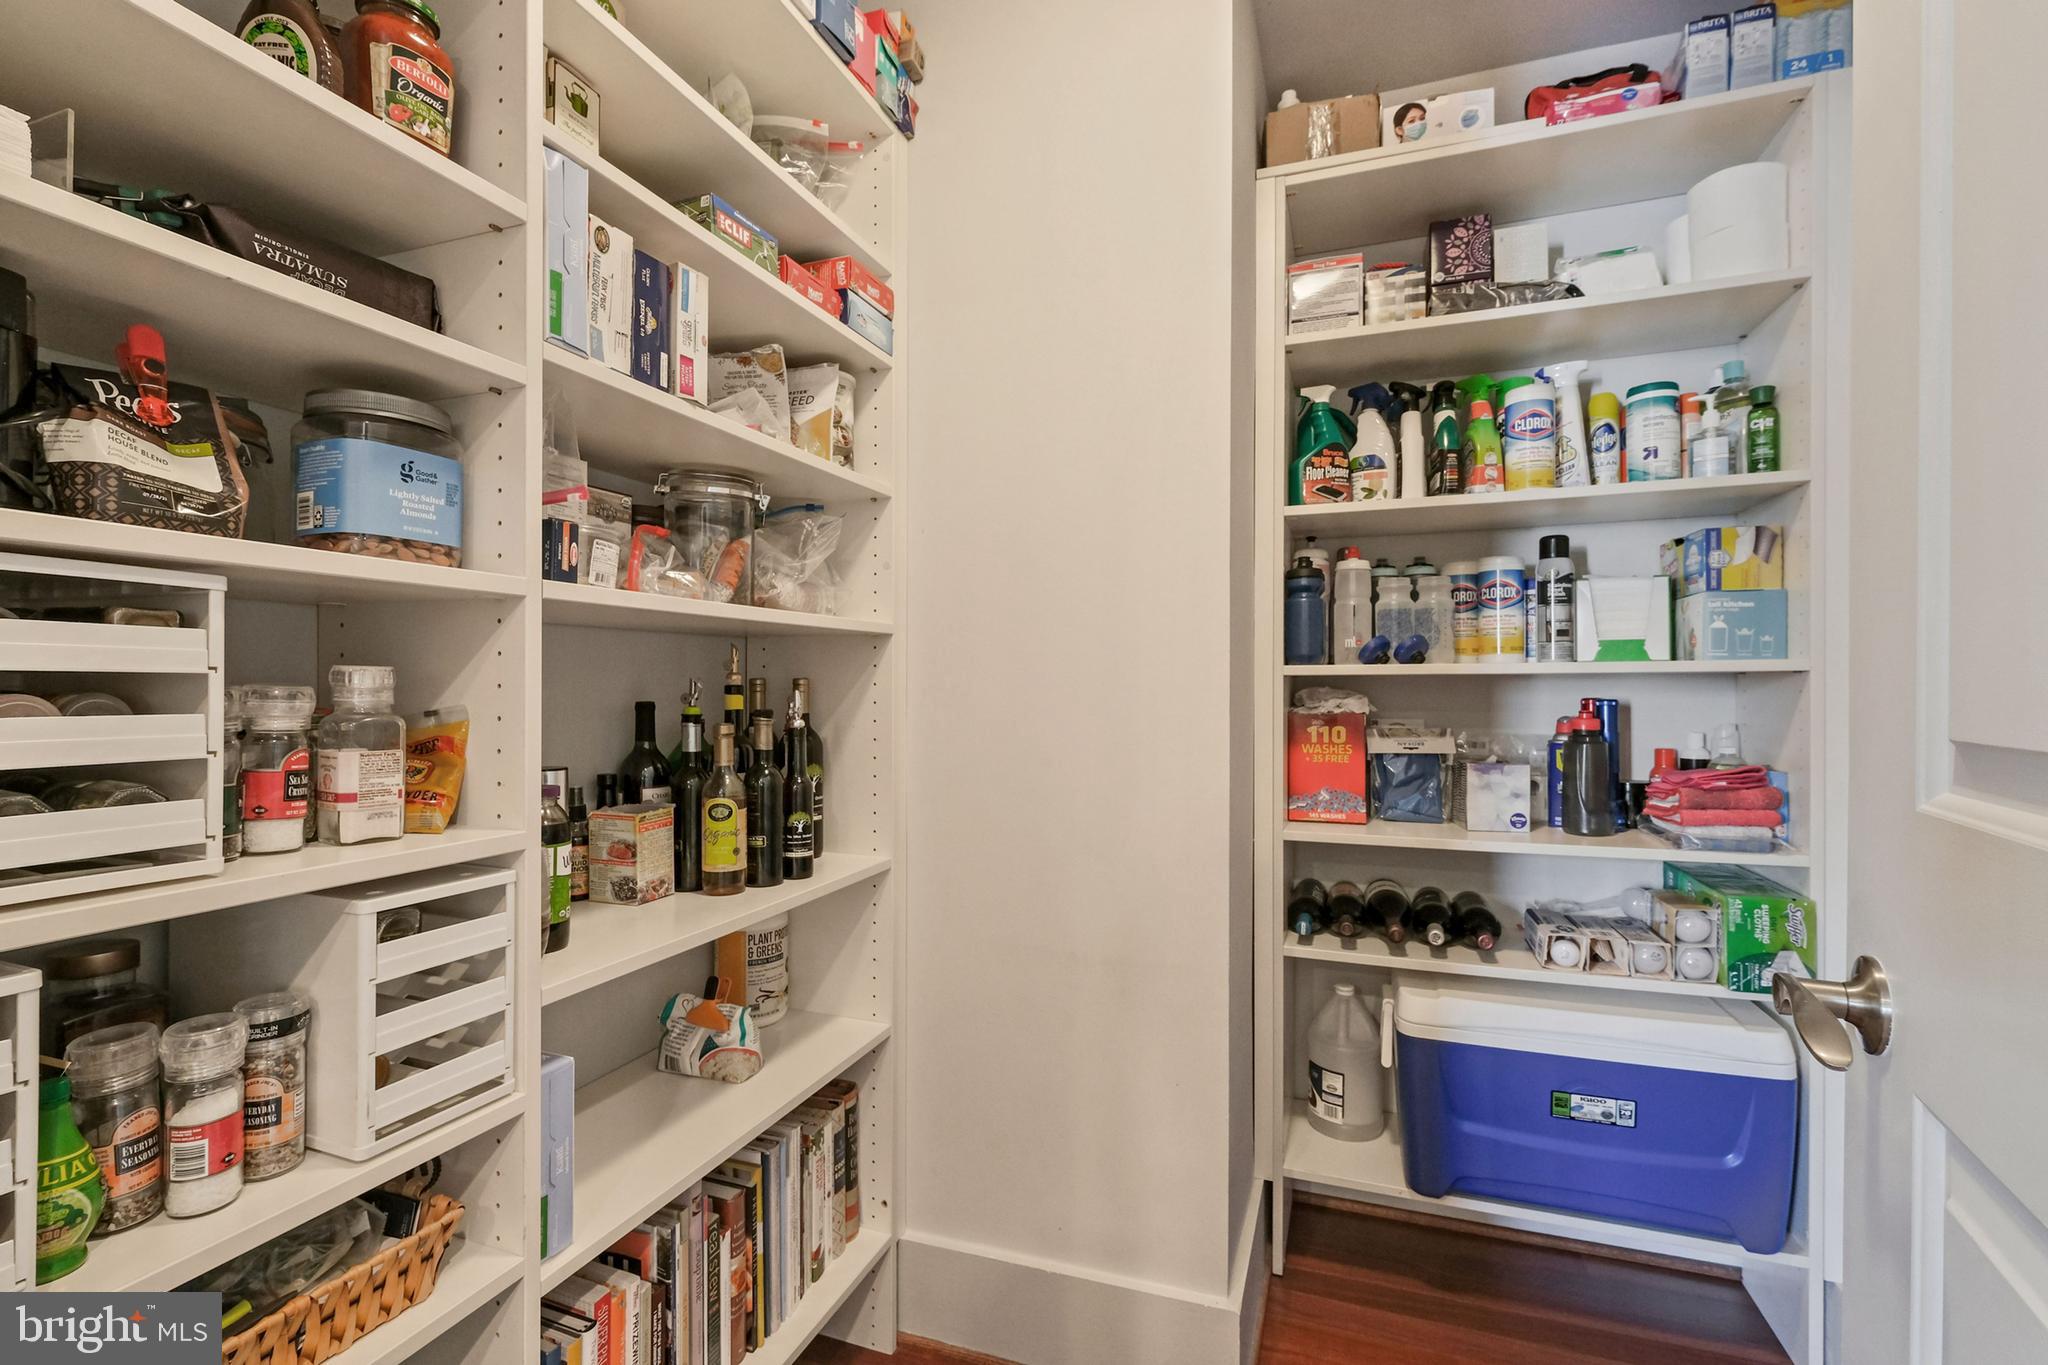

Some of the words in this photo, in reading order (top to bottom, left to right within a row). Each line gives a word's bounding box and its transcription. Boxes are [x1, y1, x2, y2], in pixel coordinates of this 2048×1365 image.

[1744, 6, 1772, 19] BRITA
[1700, 17, 1726, 28] BRITA
[1790, 59, 1808, 71] 24
[396, 59, 449, 97] BERTOLLI
[397, 77, 445, 112] Organic
[724, 218, 751, 246] CLIF
[254, 233, 310, 260] SINGLE-ORIGIN
[252, 240, 348, 289] SUMATRA
[600, 275, 609, 292] FLAX
[84, 377, 182, 425] Pees
[108, 426, 137, 444] DECAF
[1592, 431, 1617, 450] ledge
[108, 434, 140, 454] HOUSE
[141, 449, 169, 467] BLEND
[415, 475, 438, 486] Gather
[1306, 466, 1325, 481] Floor
[1325, 465, 1350, 479] Cleaner
[389, 487, 420, 502] Lightly
[420, 494, 445, 506] Salted
[400, 507, 437, 521] Almonds
[402, 499, 435, 513] Roasted
[1453, 590, 1478, 602] OROX
[1481, 587, 1517, 600] CLOROX
[1723, 600, 1755, 608] kitchen
[1307, 726, 1347, 744] 110
[1302, 743, 1353, 755] WASHES
[1312, 753, 1324, 763] 35
[1325, 753, 1350, 764] FREE
[702, 827, 741, 847] Organic
[1753, 909, 1762, 940] CLOTHS
[1761, 904, 1770, 944] SWEEPING
[1785, 903, 1804, 948] Swiffer
[747, 930, 774, 946] PLANT
[747, 946, 755, 959] &
[755, 941, 783, 958] GREENS
[1580, 1096, 1607, 1105] IGLOO
[708, 1222, 720, 1259] real
[708, 1259, 720, 1302] stew
[597, 1304, 609, 1343] SILVER
